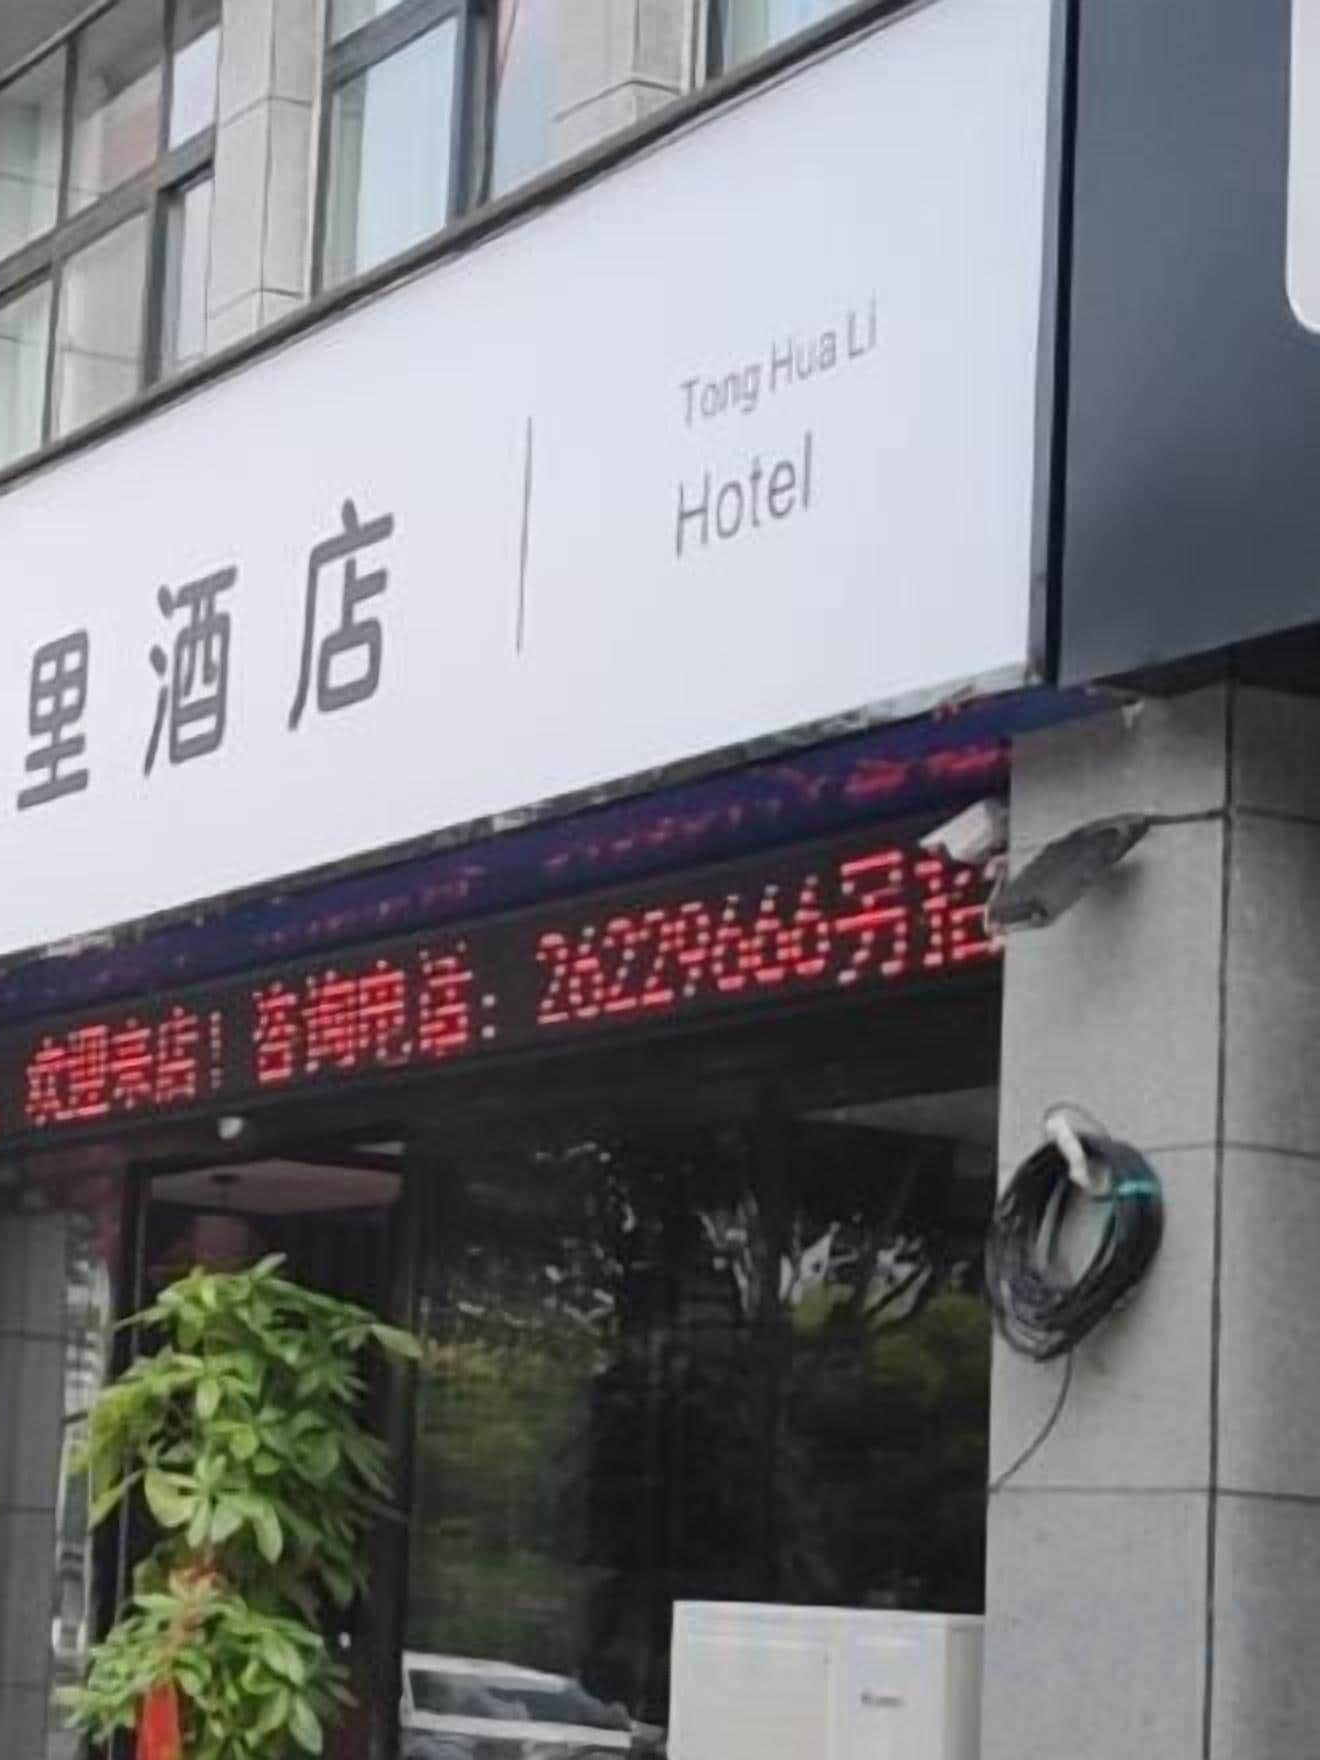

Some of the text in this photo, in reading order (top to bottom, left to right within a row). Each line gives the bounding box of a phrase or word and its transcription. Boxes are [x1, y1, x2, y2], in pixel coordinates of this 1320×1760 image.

[680, 374, 761, 429] Tong
[769, 335, 837, 395] Hua
[675, 429, 814, 560] Hotel
